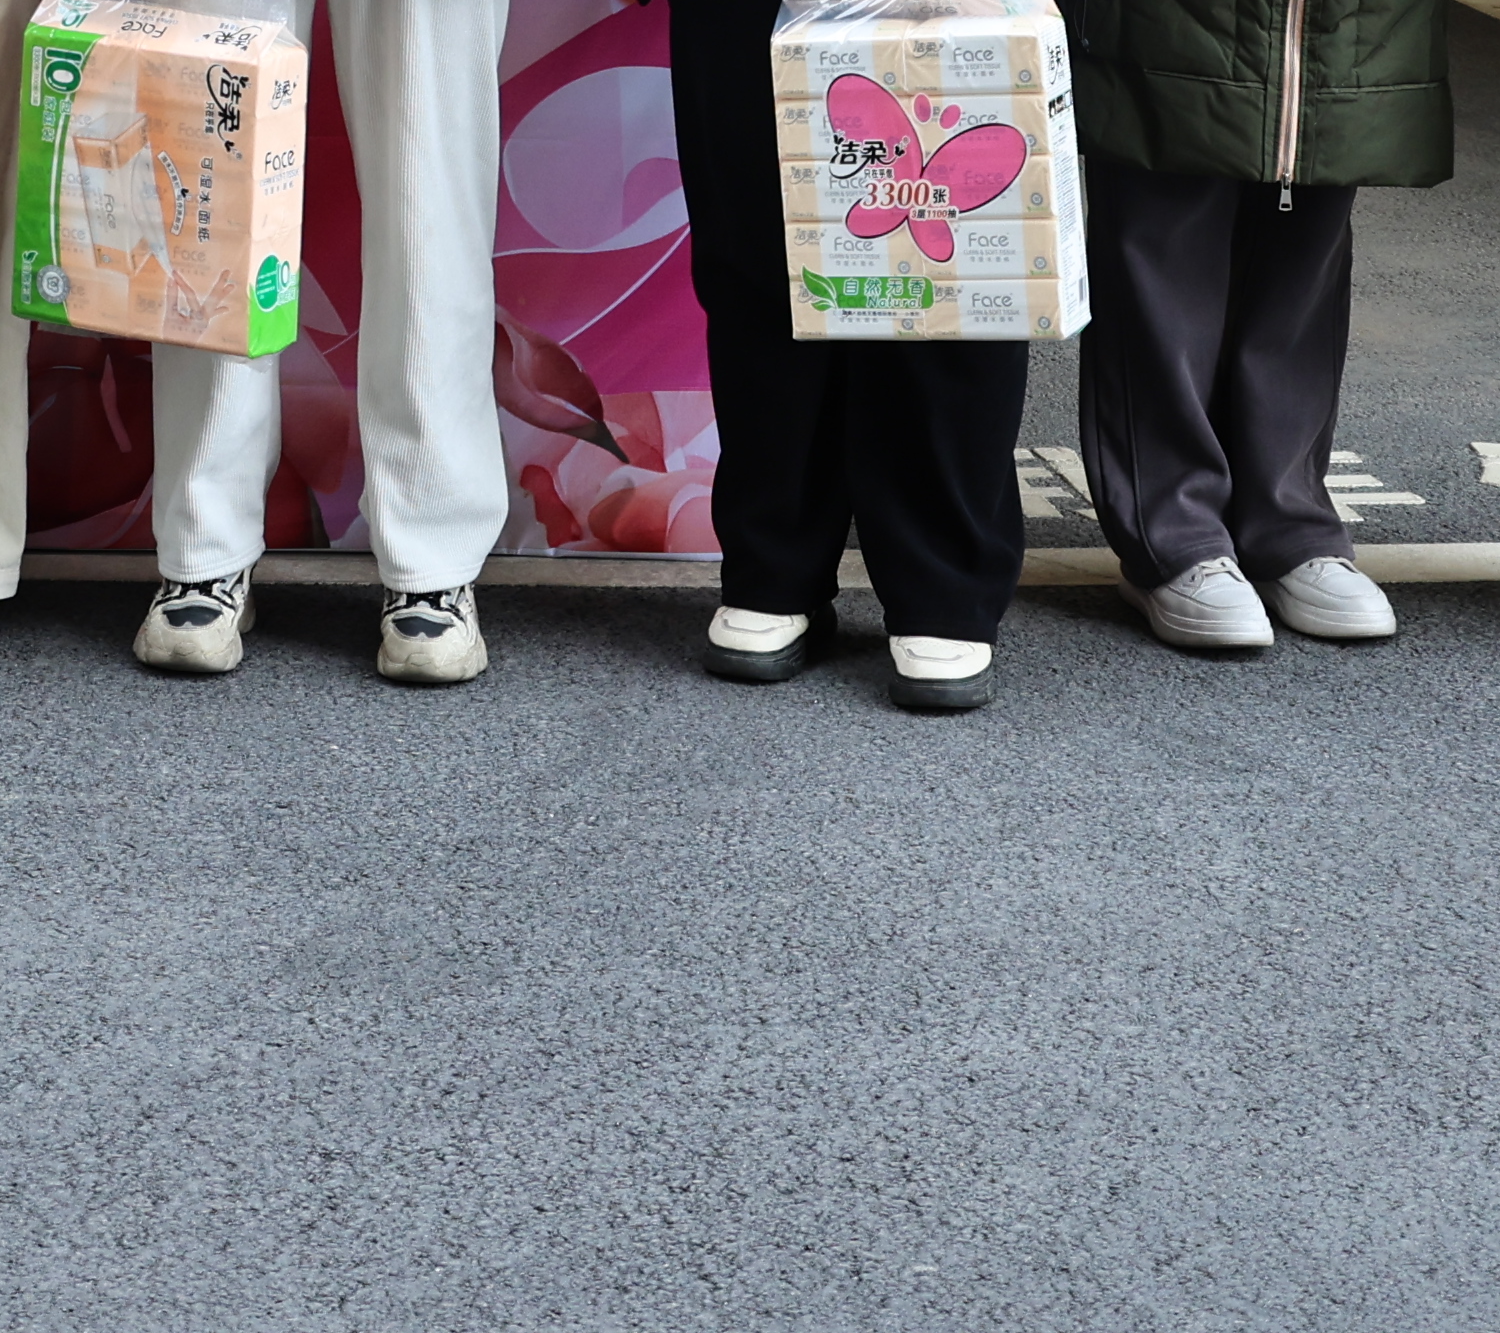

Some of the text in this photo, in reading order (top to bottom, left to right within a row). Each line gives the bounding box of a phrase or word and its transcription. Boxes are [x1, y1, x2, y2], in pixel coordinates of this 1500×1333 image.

[121, 20, 167, 39] Face
[819, 50, 859, 66] Face
[953, 47, 993, 63] Face
[44, 47, 83, 94] 10
[265, 149, 295, 174] Face
[197, 157, 214, 243] 可湿水面纸
[863, 183, 948, 208] 3300张
[834, 237, 874, 252] Face
[968, 232, 1008, 248] Face
[844, 279, 926, 295] 自然无香
[866, 296, 922, 307] Natural
[972, 293, 1012, 308] Face
